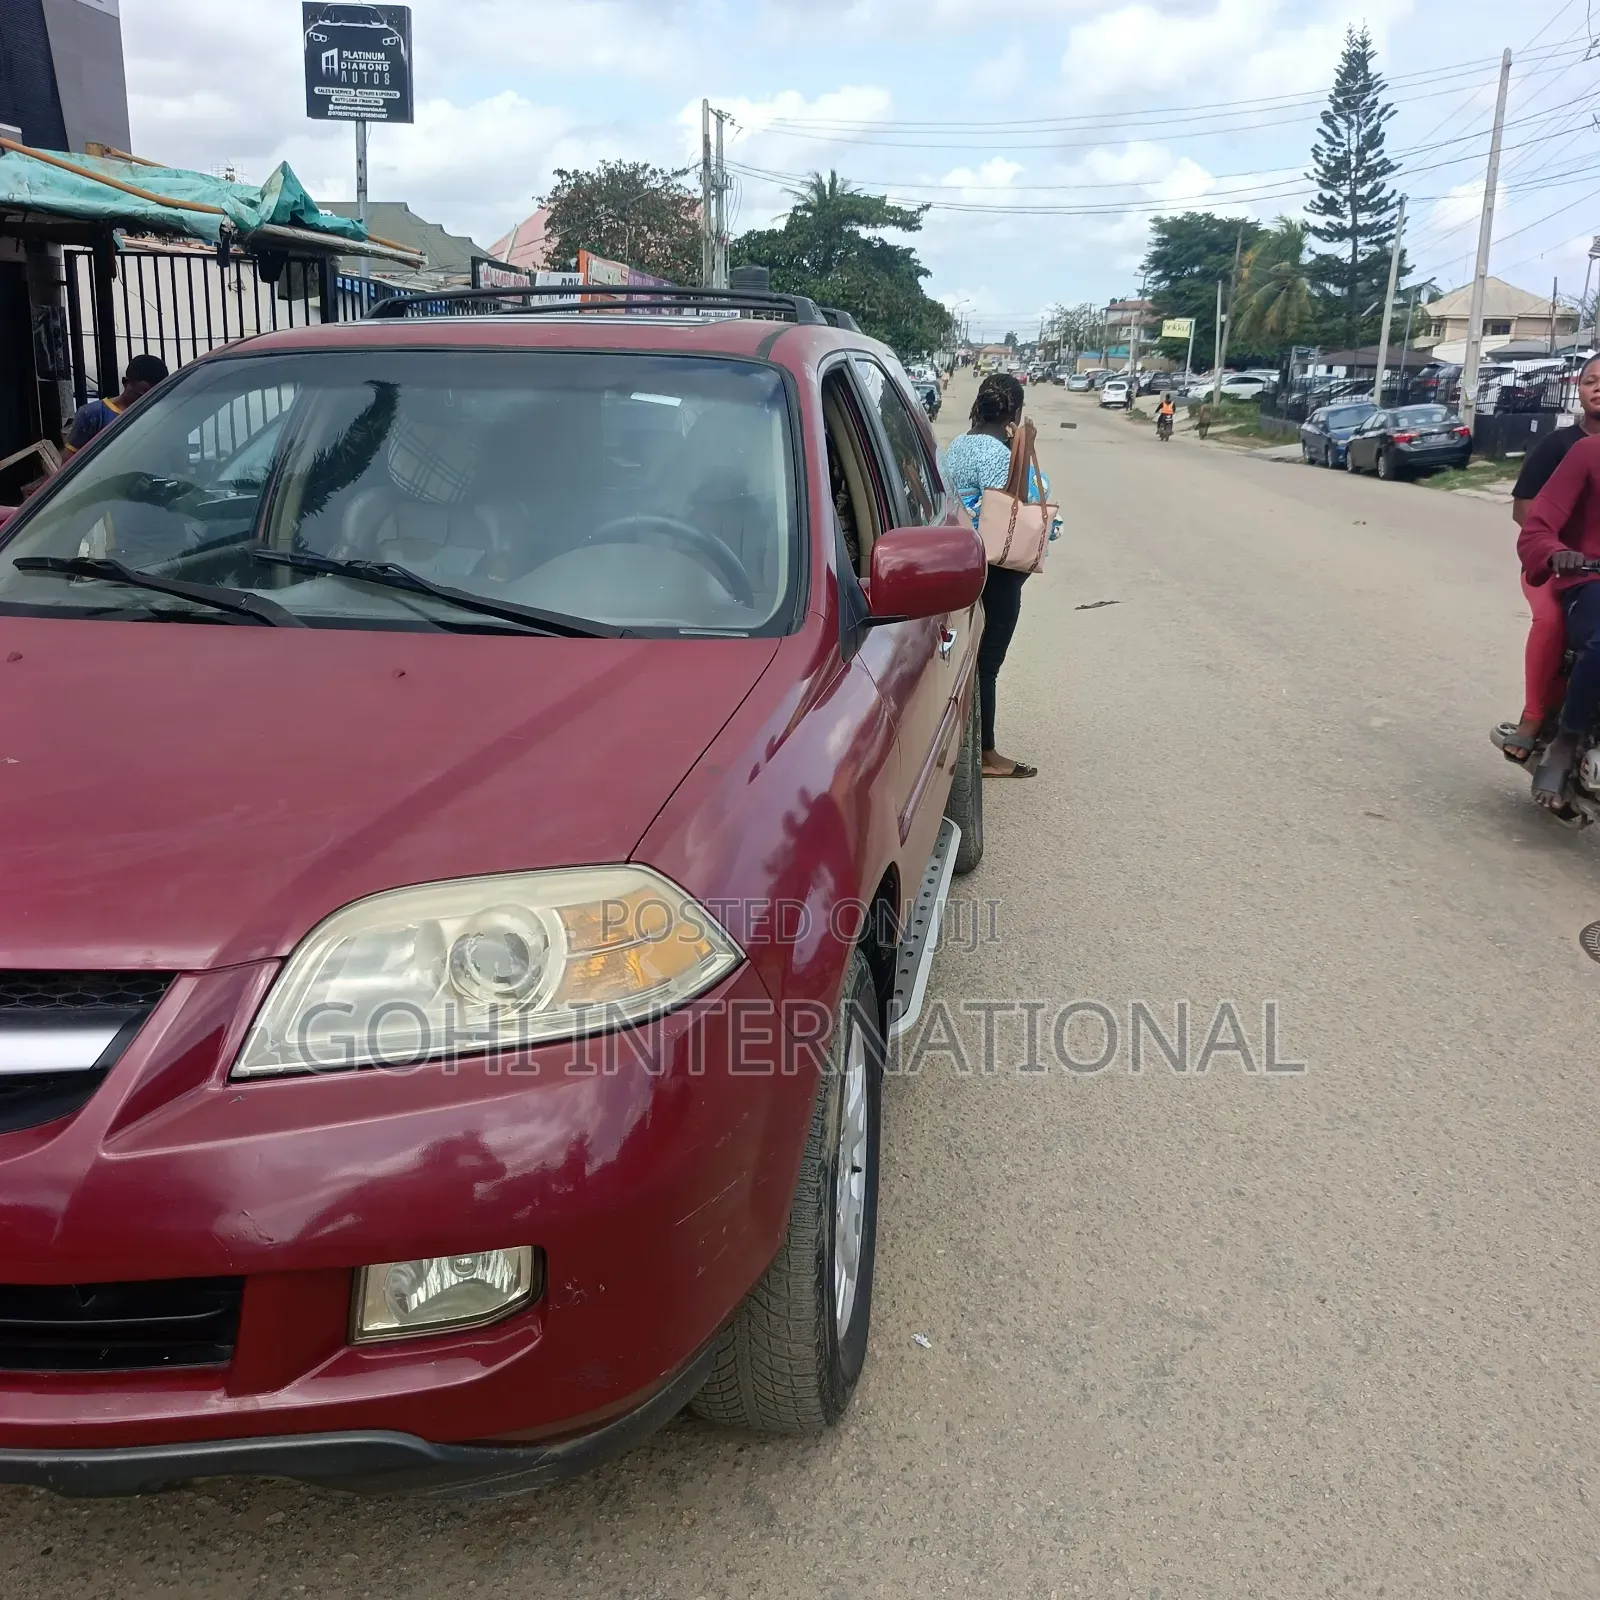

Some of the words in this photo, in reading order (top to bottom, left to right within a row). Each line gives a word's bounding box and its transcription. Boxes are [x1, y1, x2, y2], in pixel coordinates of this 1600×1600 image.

[342, 50, 386, 60] PLATINUM
[340, 61, 390, 71] DIAMOND
[341, 70, 390, 85] AUTOS
